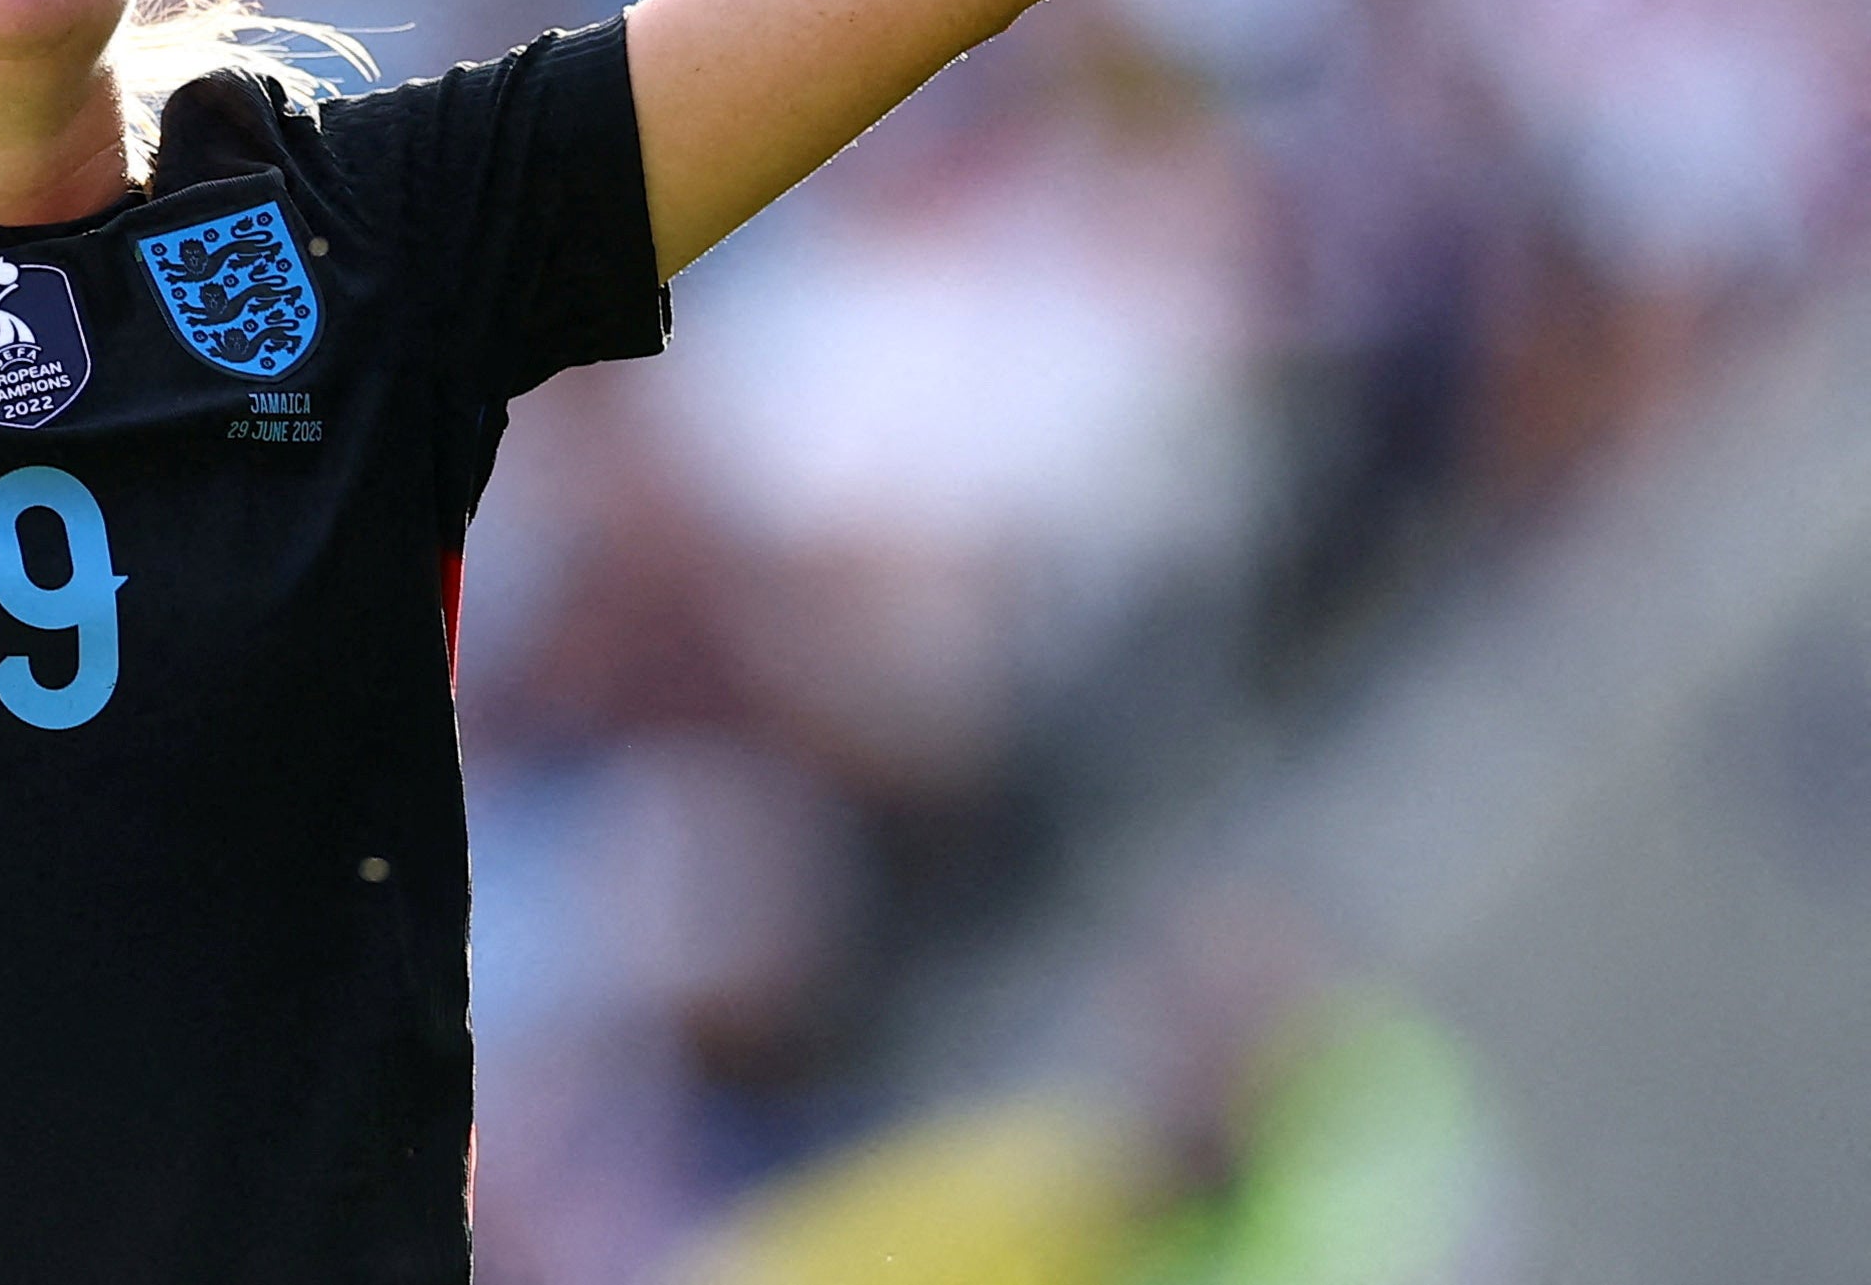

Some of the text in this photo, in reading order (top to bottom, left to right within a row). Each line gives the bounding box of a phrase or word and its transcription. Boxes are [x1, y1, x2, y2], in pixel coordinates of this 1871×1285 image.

[3, 395, 55, 419] 2022
[248, 392, 311, 414] JAMAICA
[227, 420, 323, 443] 29 JUNE 2025
